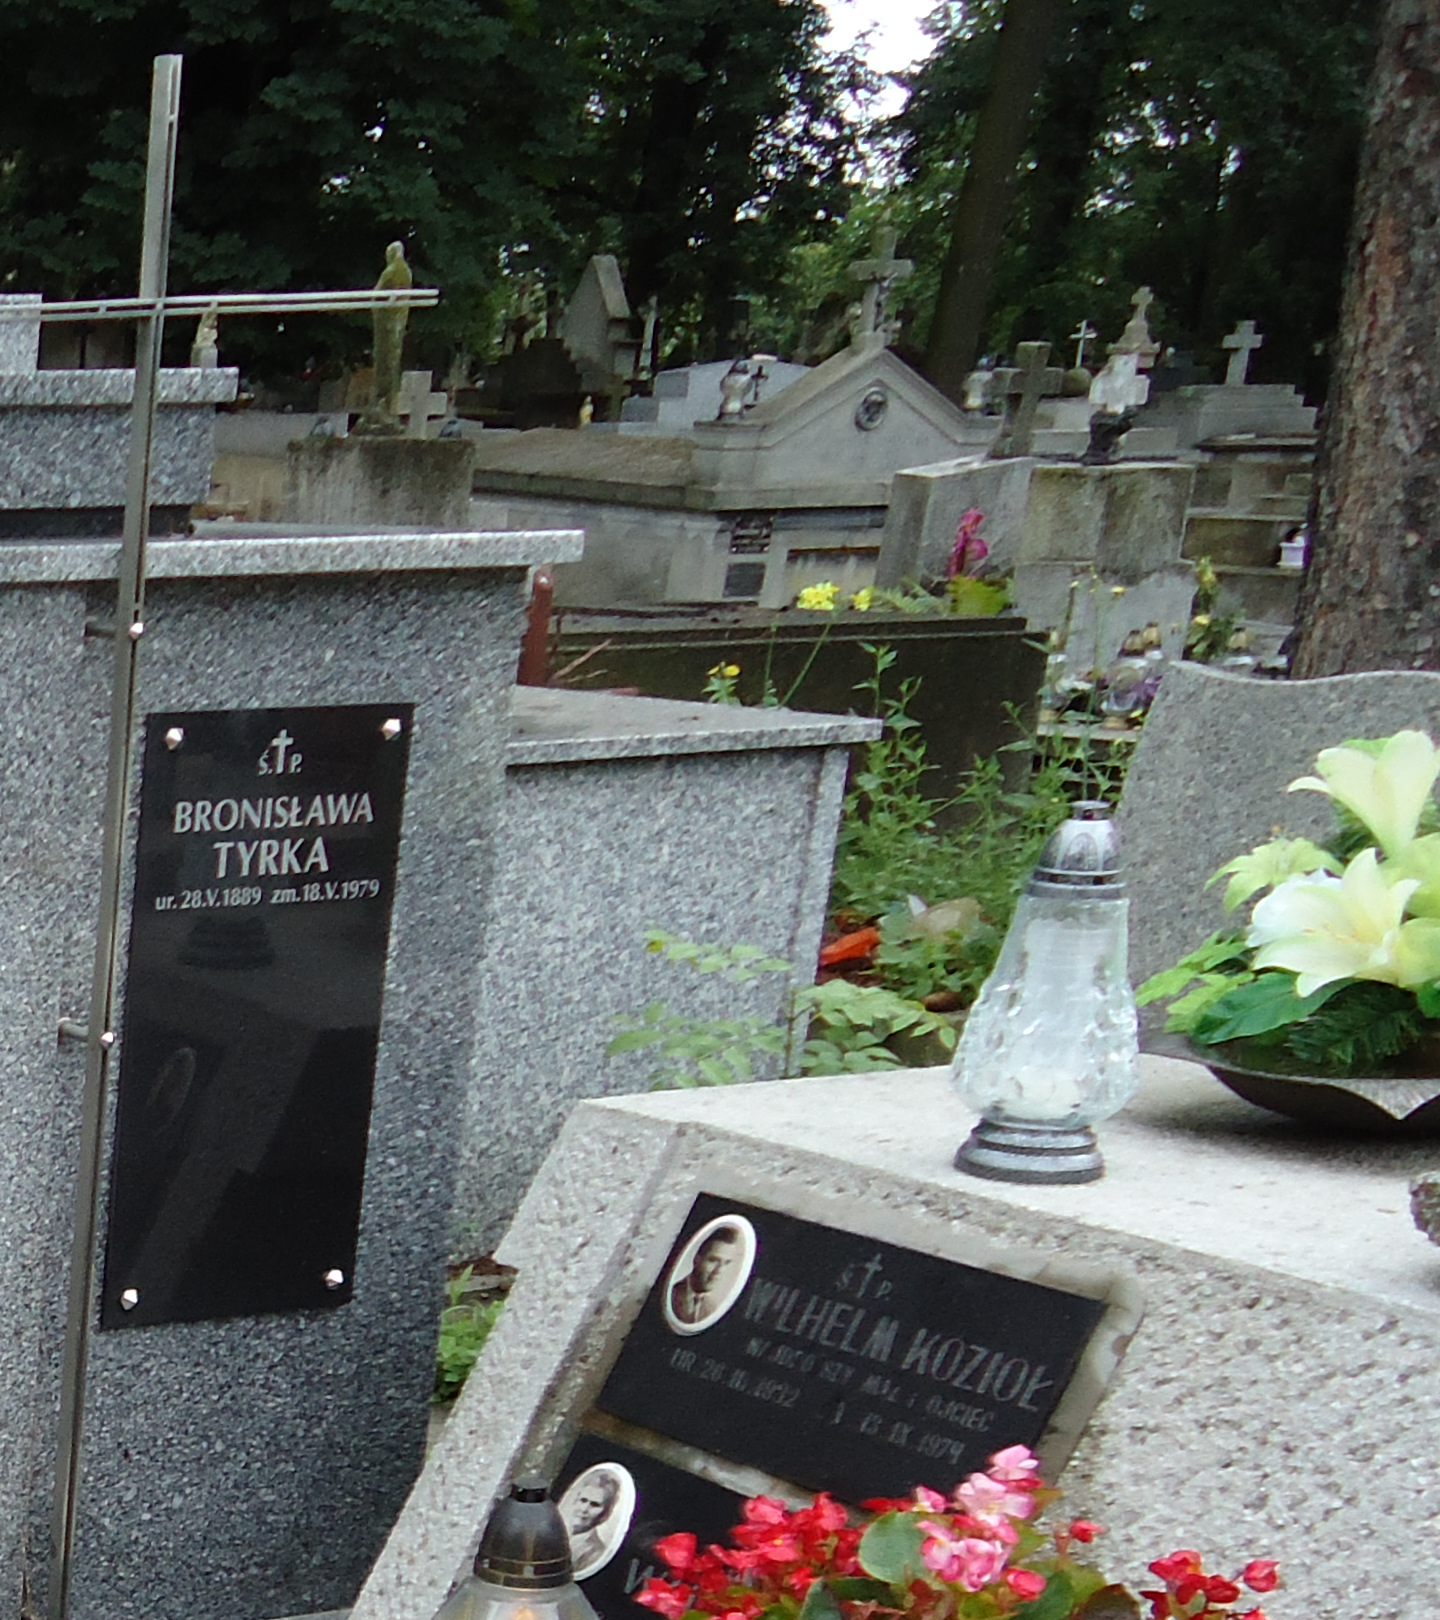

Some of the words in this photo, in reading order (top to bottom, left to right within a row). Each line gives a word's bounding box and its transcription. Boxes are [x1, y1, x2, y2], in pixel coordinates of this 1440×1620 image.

[173, 792, 374, 834] BRONISŁAWA
[213, 836, 329, 879] TYRKA
[744, 1278, 900, 1363] WILHELM
[900, 1328, 1055, 1412] KOZIOŁ
